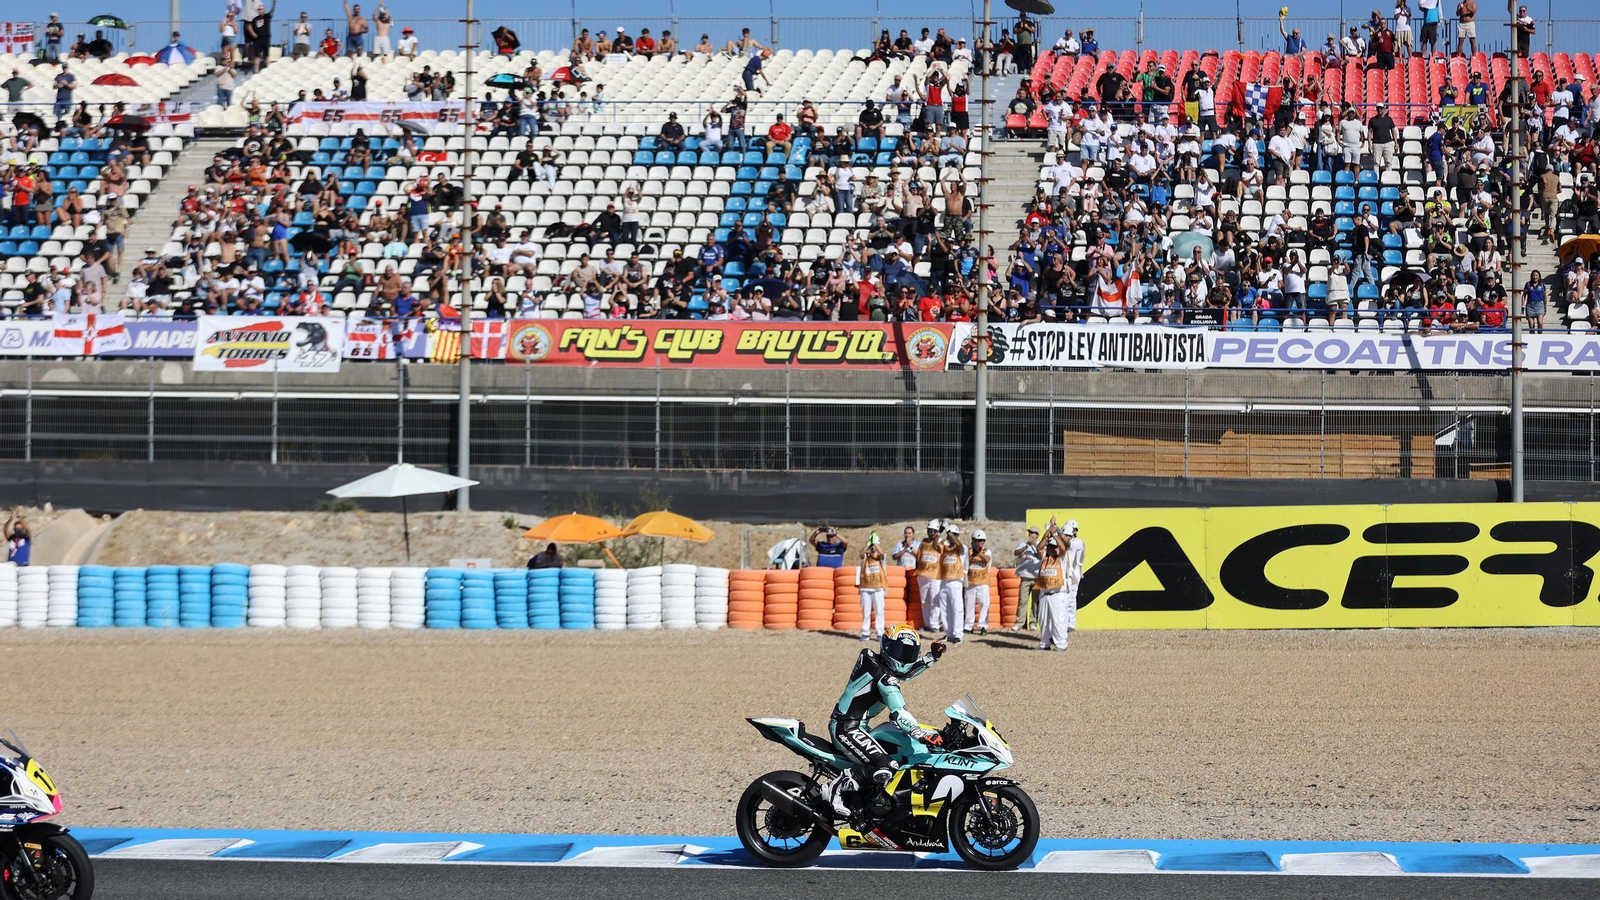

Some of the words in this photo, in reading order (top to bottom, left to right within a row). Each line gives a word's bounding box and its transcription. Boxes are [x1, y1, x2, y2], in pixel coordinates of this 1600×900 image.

[322, 109, 345, 123] 65
[381, 109, 402, 123] 65
[437, 108, 461, 123] 65
[134, 330, 198, 349] MAPE
[205, 331, 292, 343] ANTONIO
[558, 325, 649, 362] FAN'S
[653, 328, 725, 363] CLUB
[216, 347, 290, 360] TORRES
[1010, 330, 1066, 361] #STOP
[1068, 331, 1096, 361] LEY
[1098, 332, 1206, 363] ANTIBAUTISTA
[1211, 338, 1413, 364] PECOAT
[1423, 340, 1527, 366] TNS
[294, 350, 337, 368] 47
[1074, 520, 1600, 612] ACER
[848, 729, 883, 755] KLINT
[943, 754, 979, 769] KLINT
